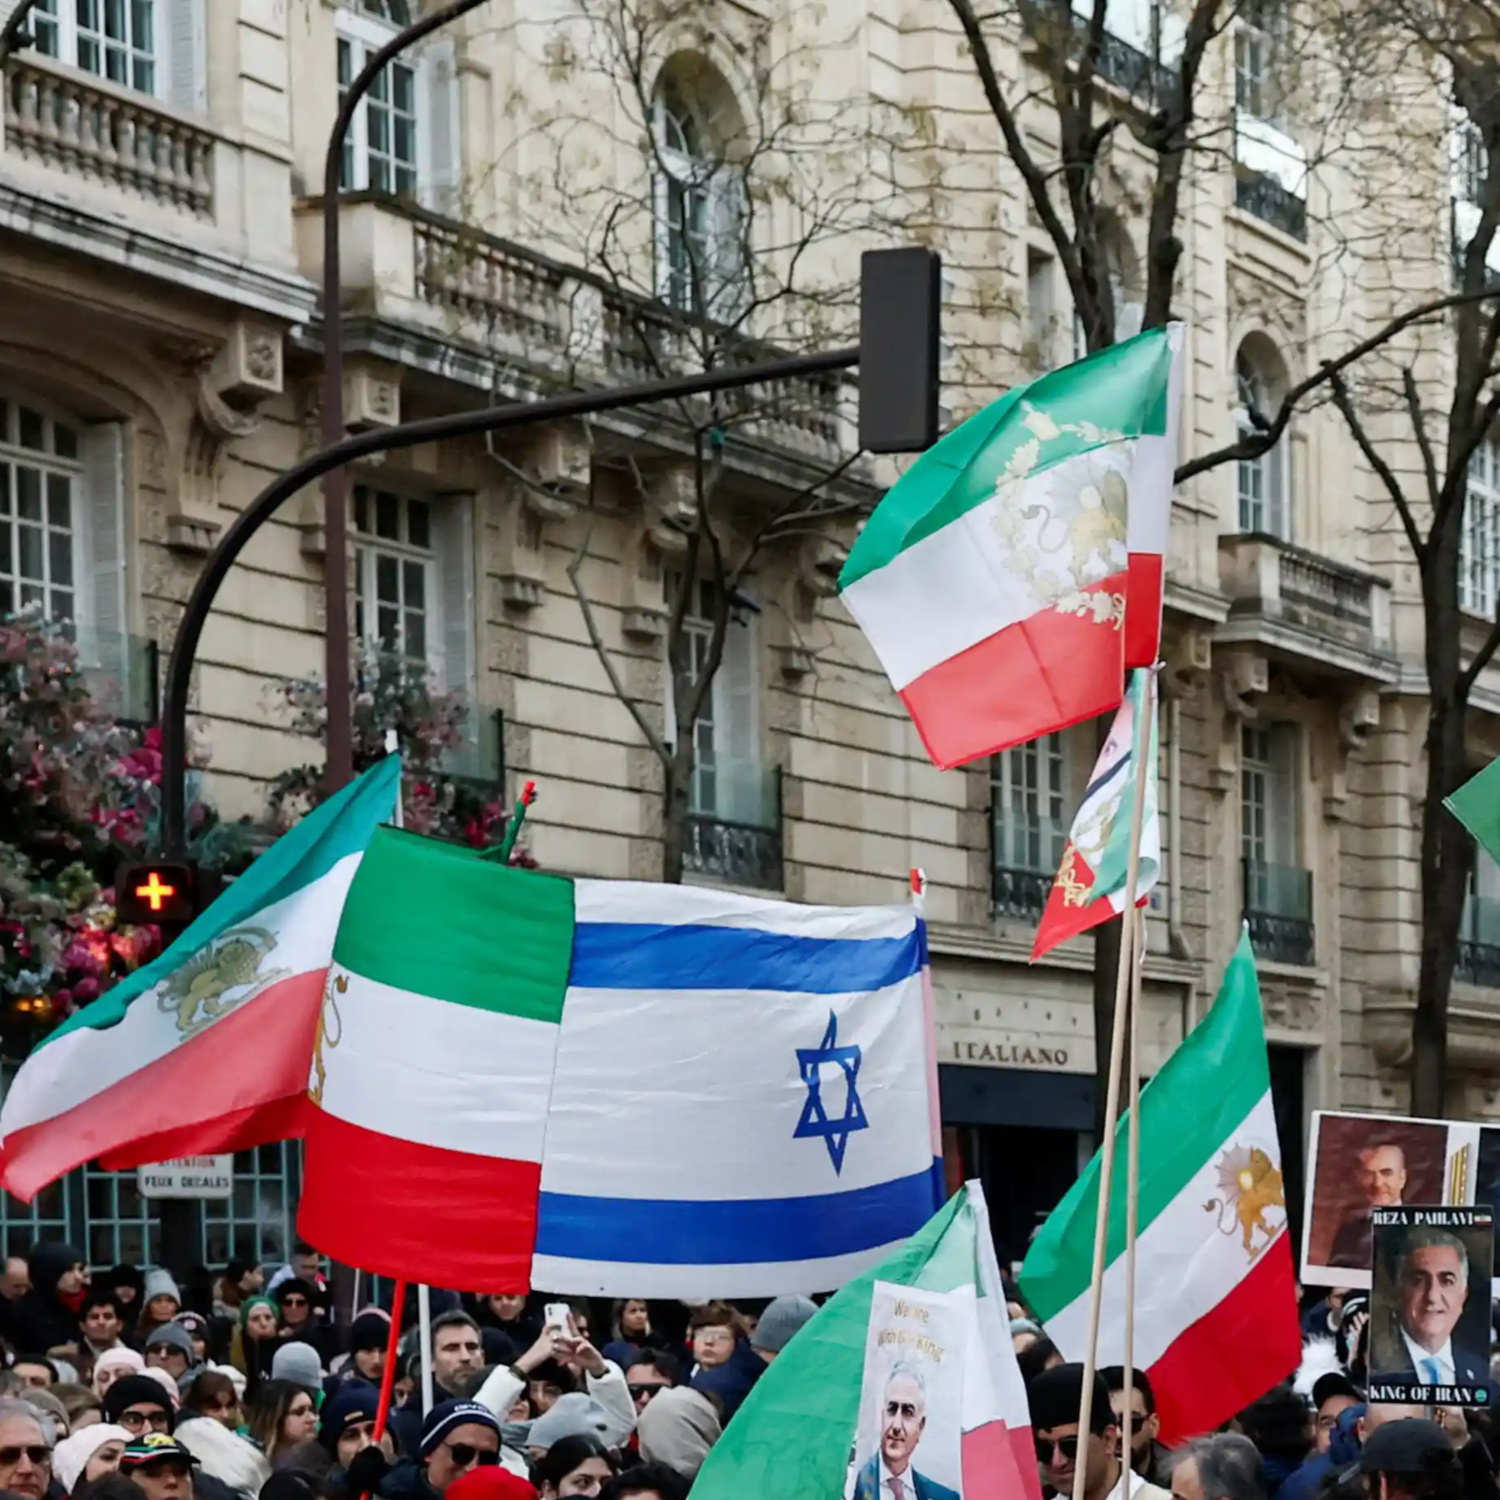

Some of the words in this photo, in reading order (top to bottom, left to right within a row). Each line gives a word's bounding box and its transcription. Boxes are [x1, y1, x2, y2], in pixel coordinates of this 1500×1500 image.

[953, 1041, 1068, 1066] ITALIANO
[145, 1176, 172, 1187] FEUX
[1373, 1211, 1408, 1225] REZA
[1414, 1211, 1473, 1225] PAHLAVI
[1370, 1385, 1406, 1400] KING
[1410, 1386, 1430, 1401] OF
[1435, 1387, 1472, 1402] IRAN
